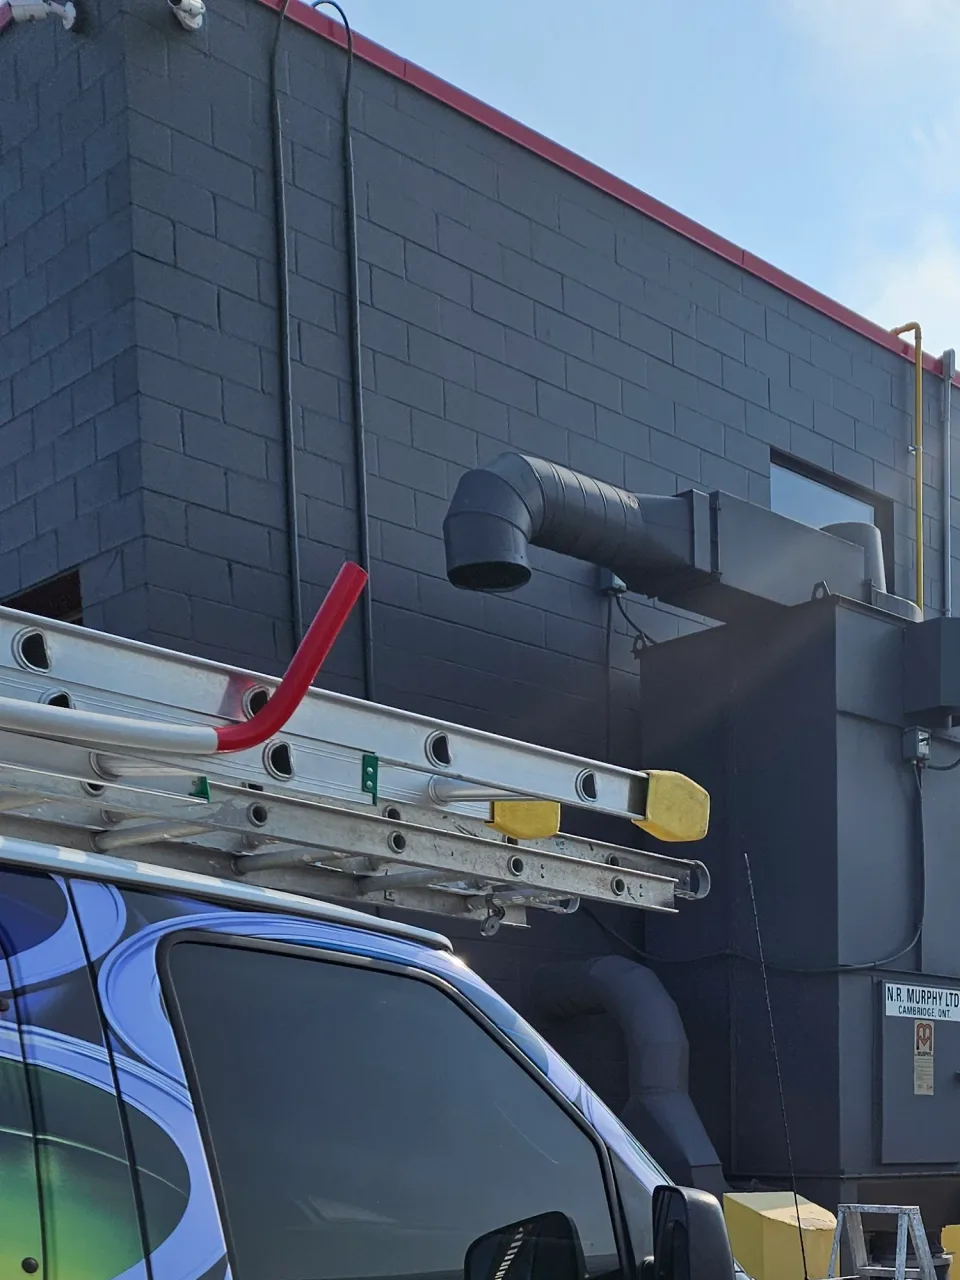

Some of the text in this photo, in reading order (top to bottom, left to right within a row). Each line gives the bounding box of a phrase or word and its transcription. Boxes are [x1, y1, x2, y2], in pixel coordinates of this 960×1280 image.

[887, 986, 904, 1003] N.R.
[907, 988, 943, 1007] MURPHY
[898, 1004, 952, 1019] CAMBRIDGE, ONT.
